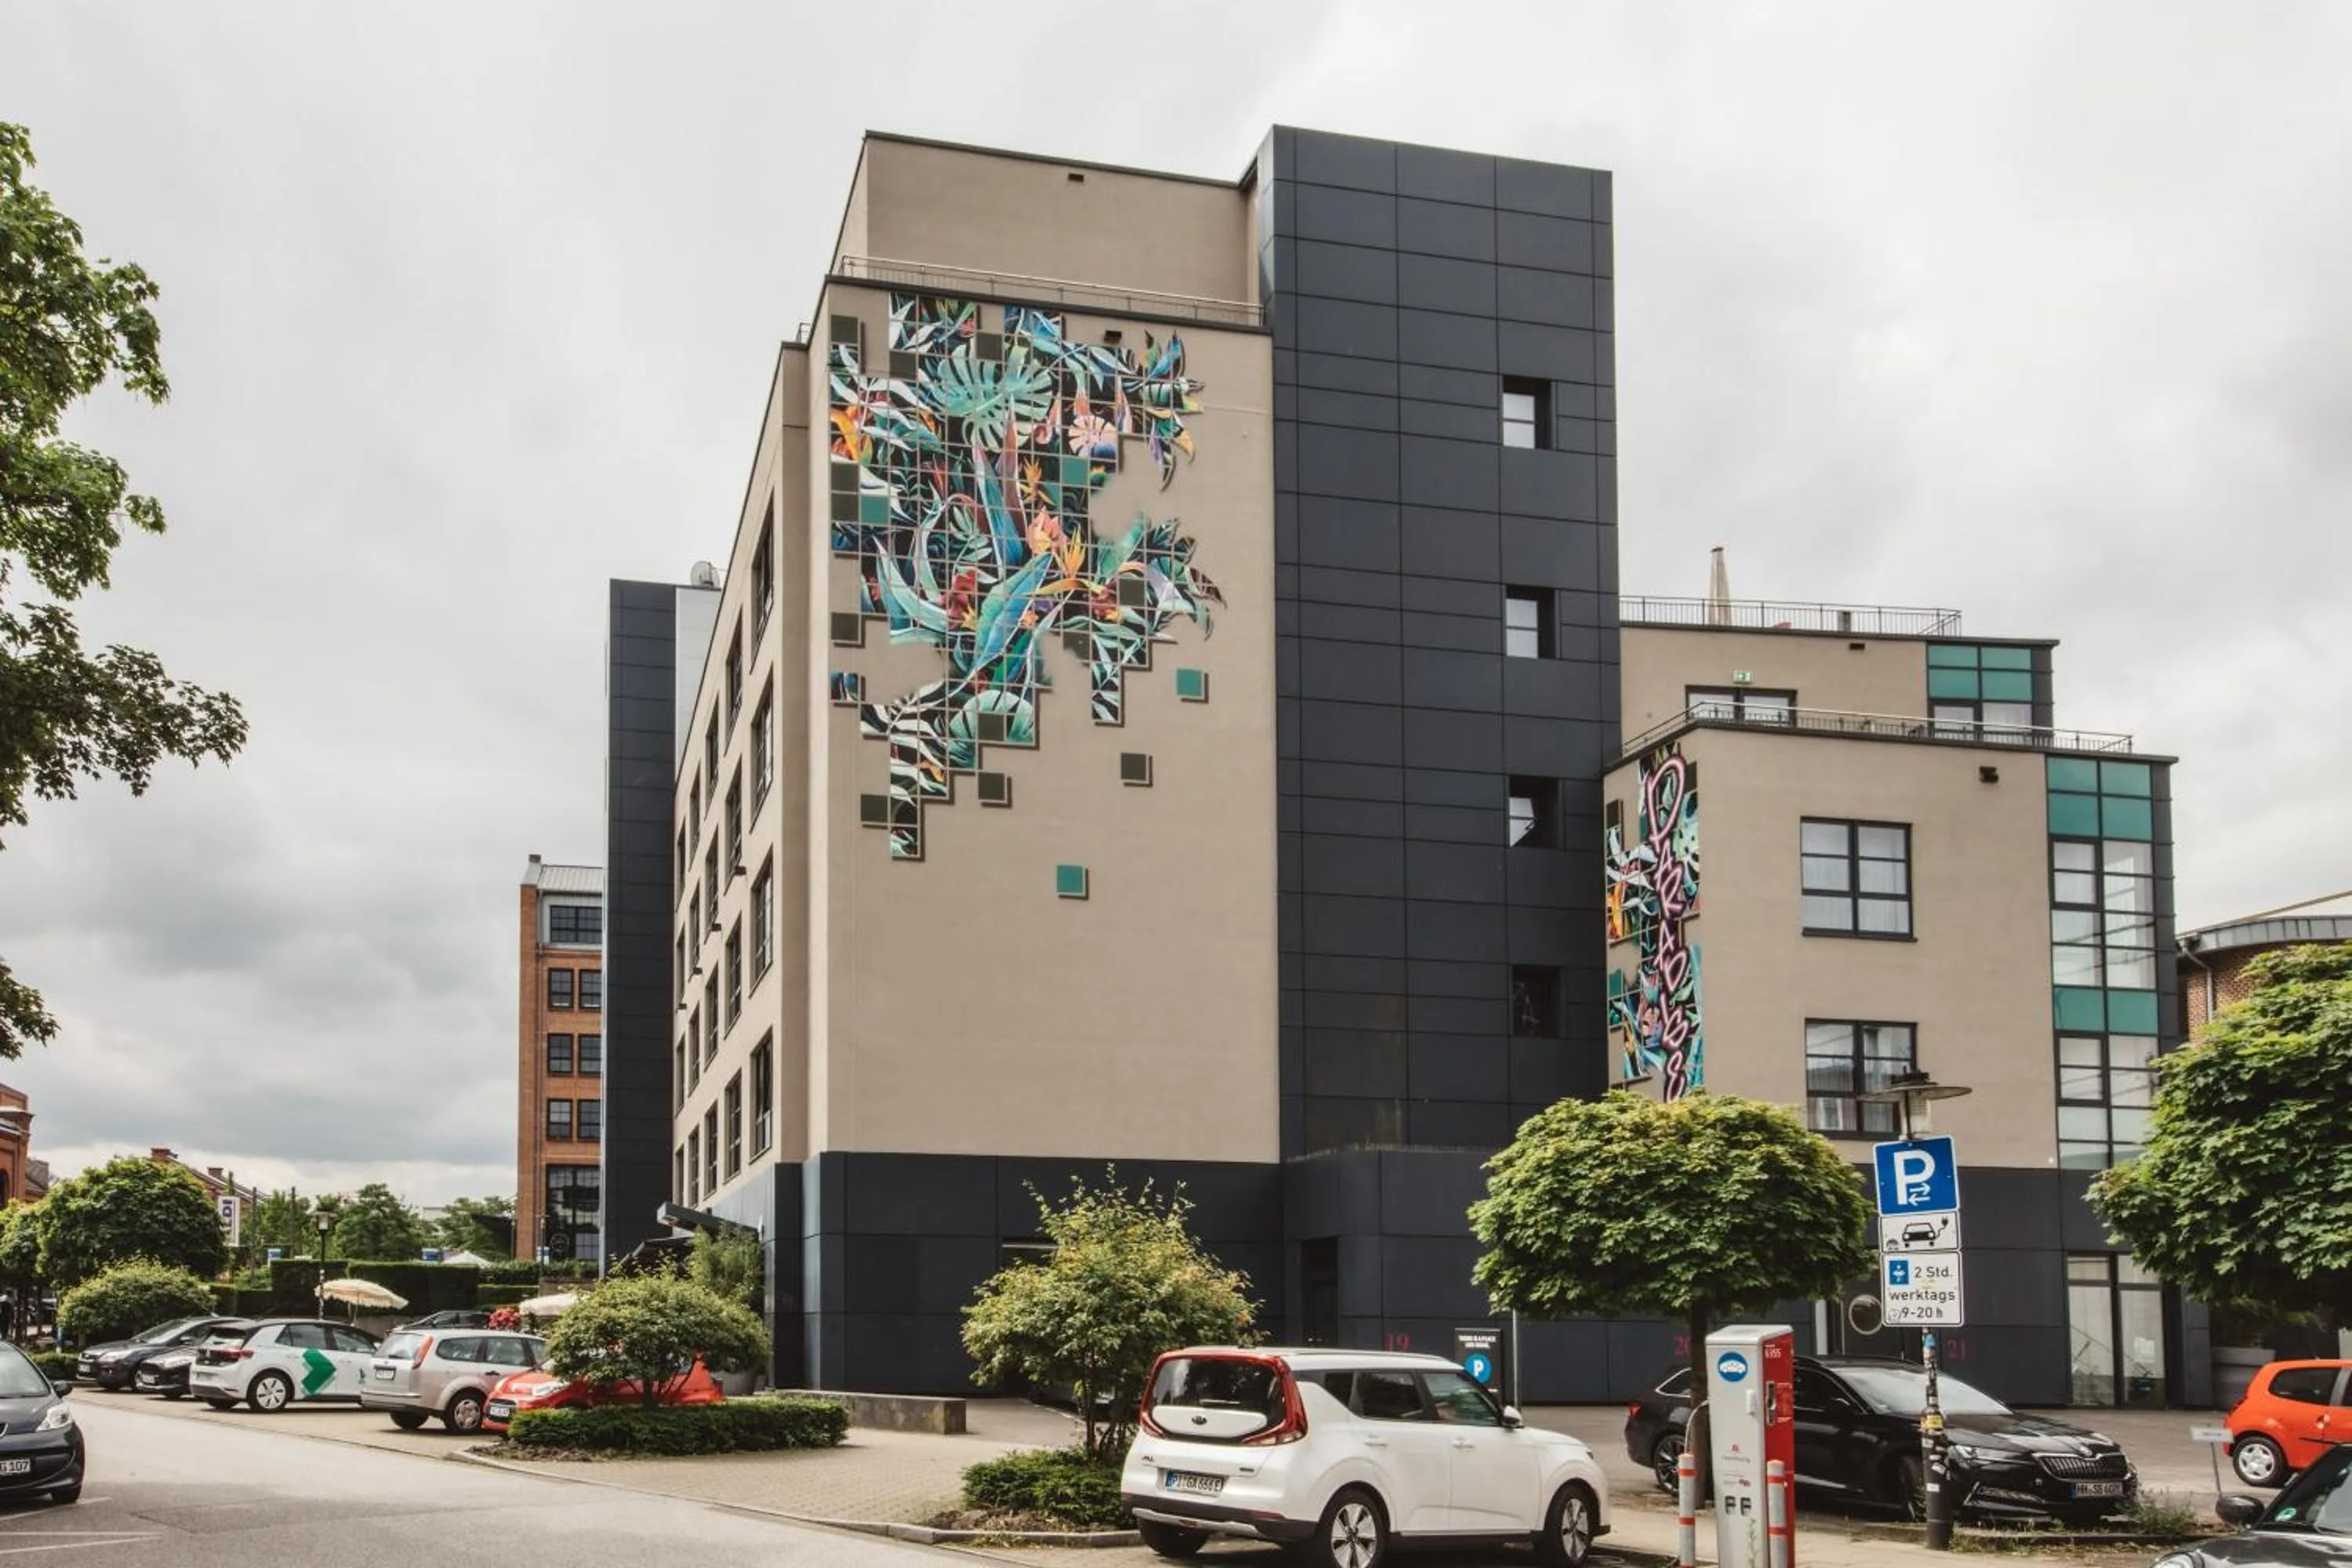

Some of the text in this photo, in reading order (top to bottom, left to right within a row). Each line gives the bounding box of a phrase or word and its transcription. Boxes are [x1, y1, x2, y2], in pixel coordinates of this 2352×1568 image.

[1893, 1149, 1935, 1205] P
[1915, 1266, 1953, 1279] 2 Std.
[1888, 1290, 1955, 1304] werktags
[1901, 1306, 1944, 1319] 9-20 h
[1387, 1332, 1410, 1352] 19
[1947, 1339, 1965, 1362] 21
[1474, 1359, 1484, 1377] P
[9, 1461, 29, 1472] 107
